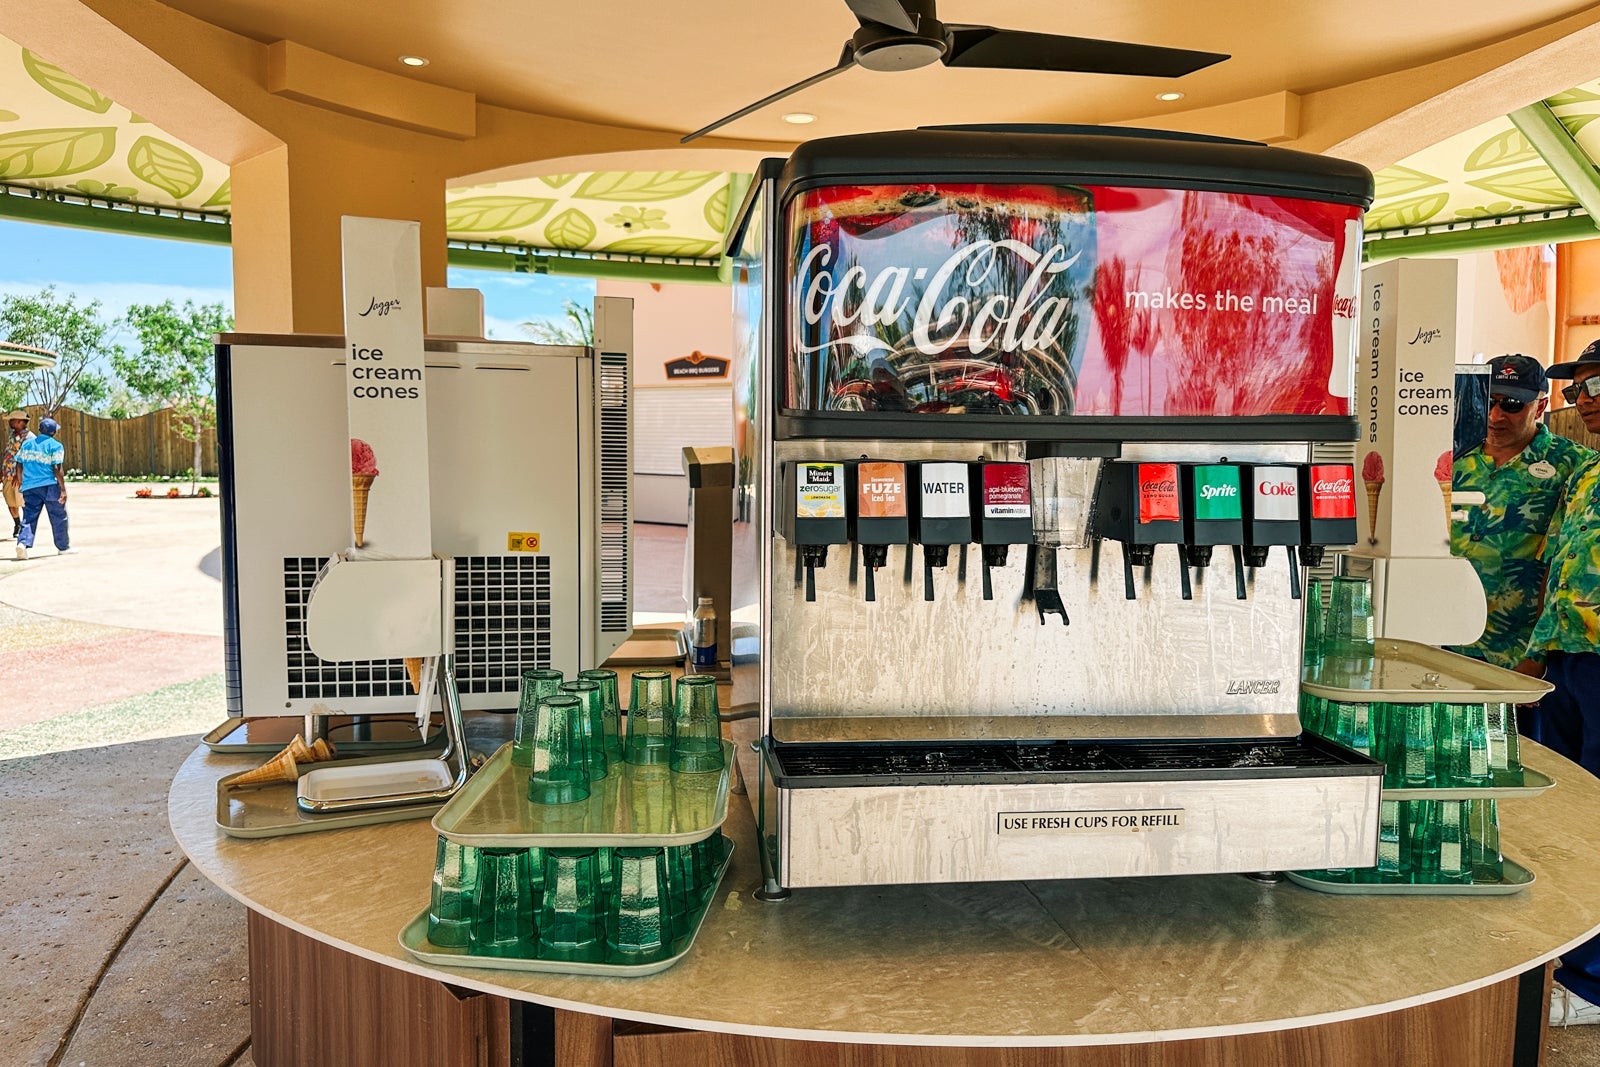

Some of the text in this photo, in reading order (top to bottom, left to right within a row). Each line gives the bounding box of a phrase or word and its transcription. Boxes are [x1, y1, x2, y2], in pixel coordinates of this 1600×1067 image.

[358, 296, 400, 317] Jagger
[1125, 287, 1318, 315] makes the meal
[1408, 327, 1441, 345] Jagger
[352, 343, 383, 361] ice
[1369, 283, 1384, 443] ice cream cones
[352, 367, 422, 381] cream
[1399, 368, 1424, 383] ice
[353, 386, 419, 399] cones
[1398, 388, 1452, 399] cream
[1398, 404, 1449, 416] cones
[863, 483, 902, 494] FUZE
[924, 482, 965, 494] WATER
[1200, 484, 1237, 500] Sprite
[1259, 481, 1296, 496] Coke
[871, 494, 896, 502] Iced Tea
[1226, 680, 1280, 694] LANCER
[1004, 814, 1180, 830] USE FRESH CUPS FOR REFILL
